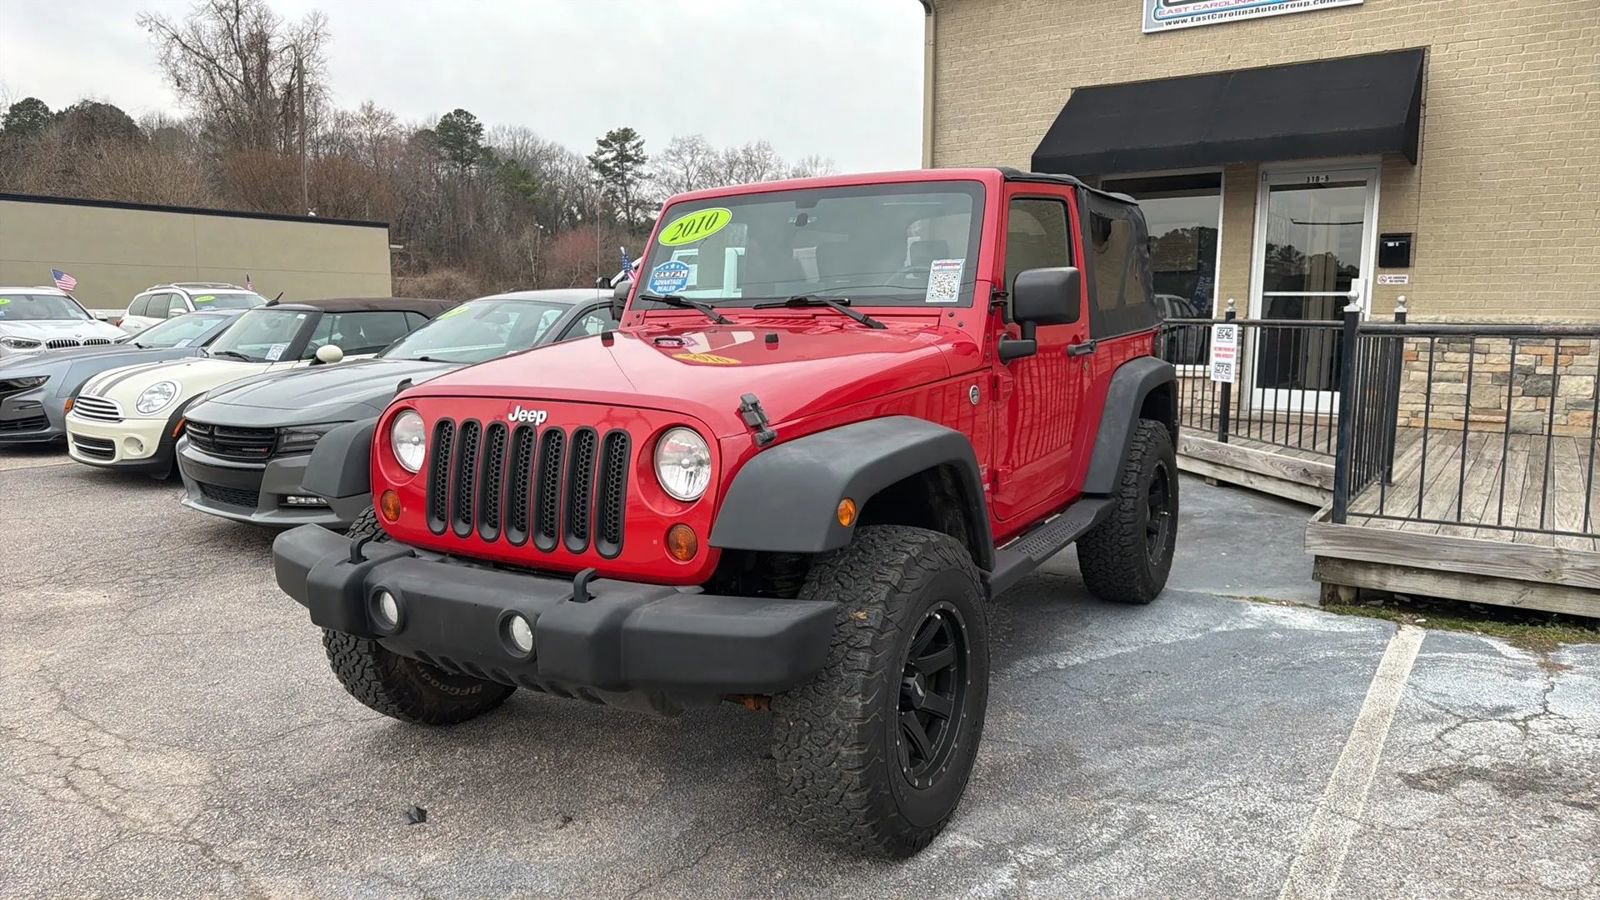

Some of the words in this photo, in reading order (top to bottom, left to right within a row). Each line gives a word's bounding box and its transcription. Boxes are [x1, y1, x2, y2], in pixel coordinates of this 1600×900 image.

[1158, 6, 1190, 16] EAST
[669, 211, 719, 242] 2010
[508, 405, 548, 426] Jeep
